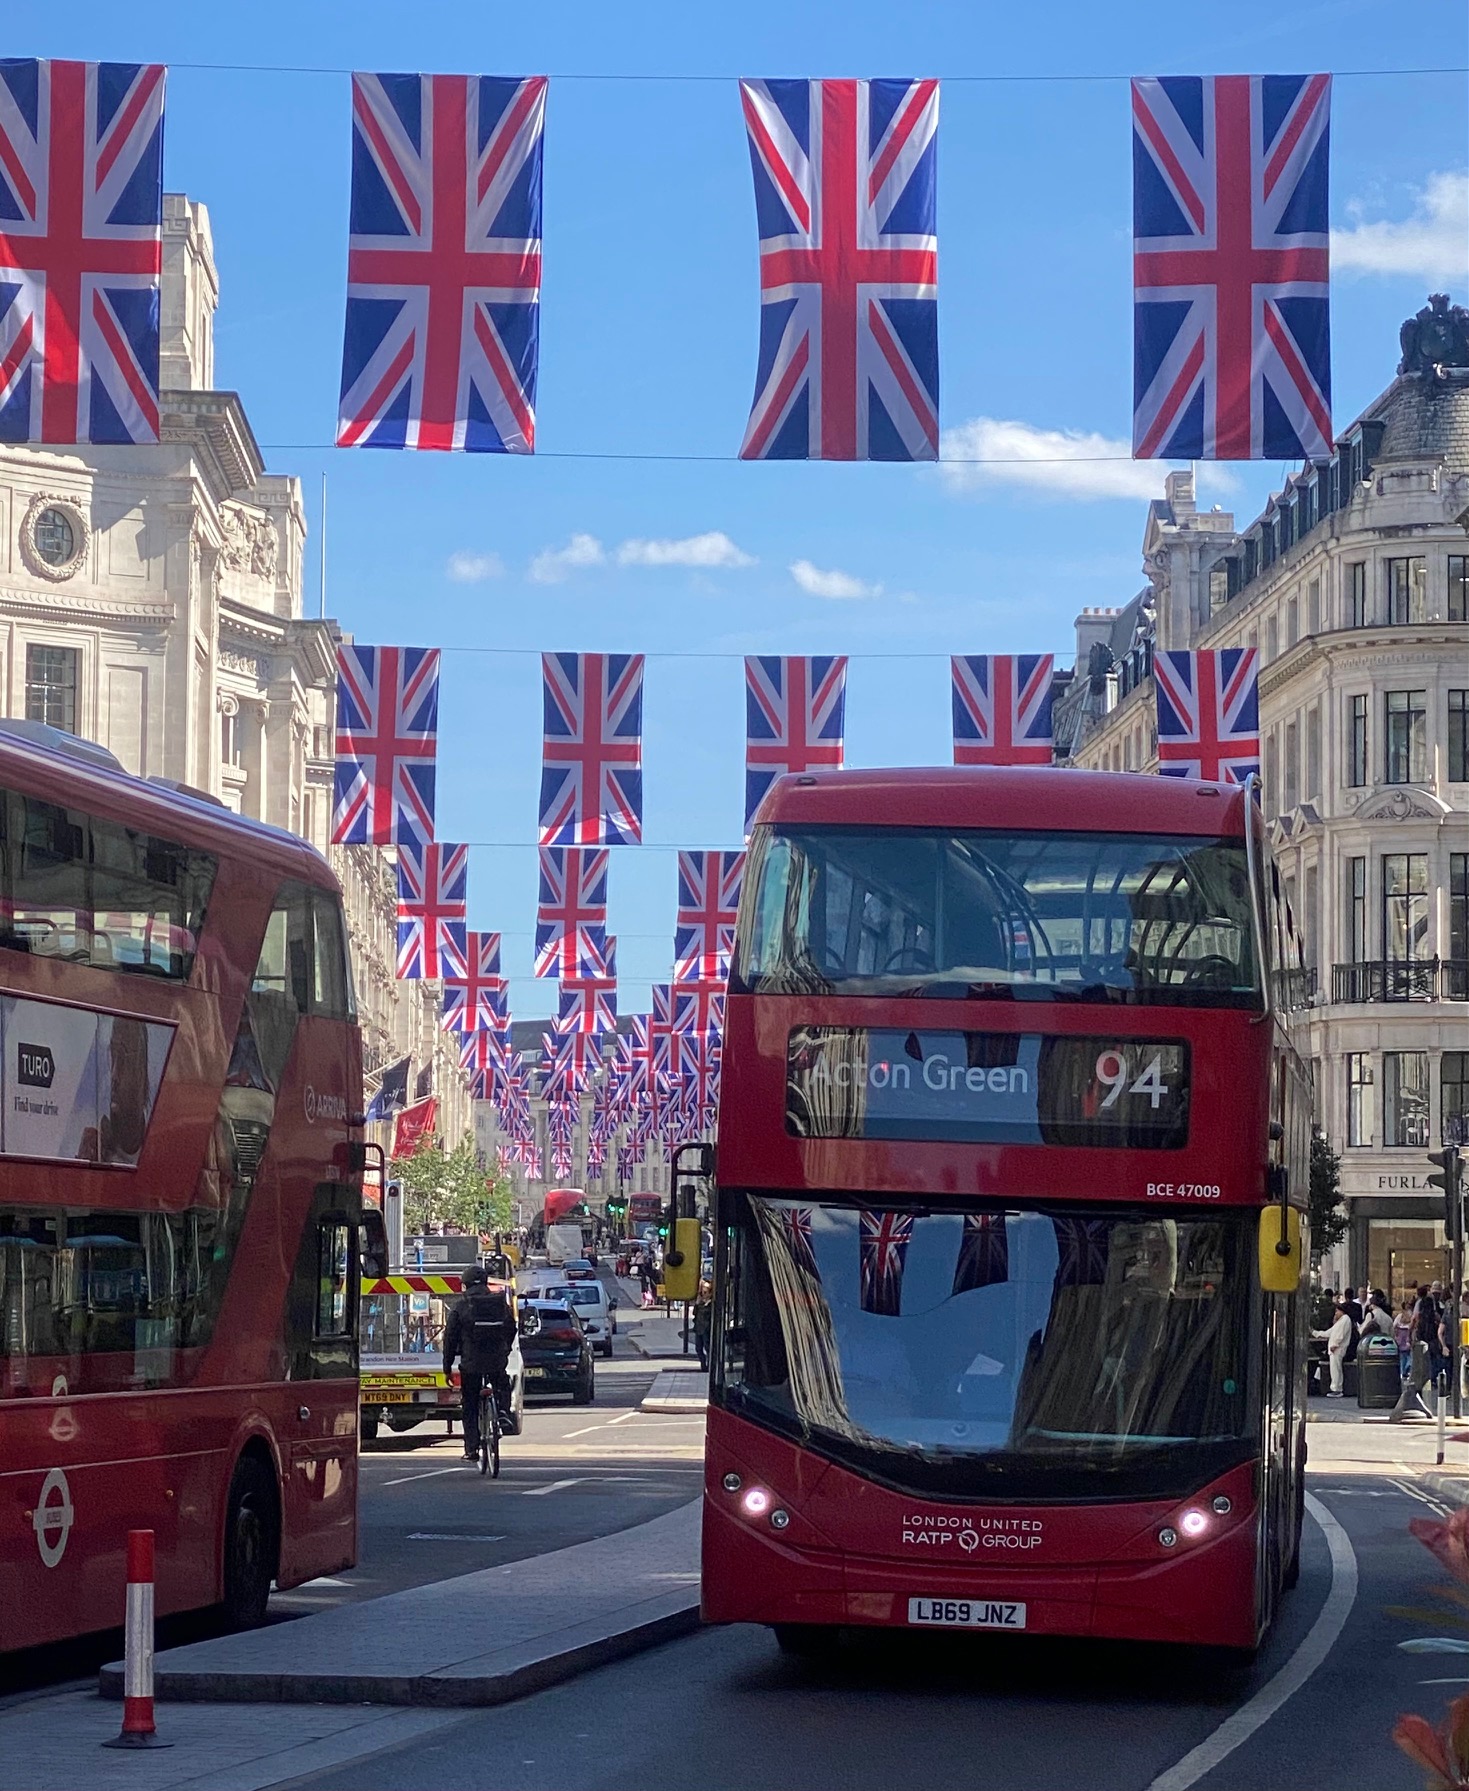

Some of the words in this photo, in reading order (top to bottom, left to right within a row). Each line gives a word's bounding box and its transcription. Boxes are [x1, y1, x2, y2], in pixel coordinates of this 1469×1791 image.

[22, 1053, 50, 1078] TURO
[810, 1051, 910, 1089] Acton
[922, 1053, 1028, 1093] Green
[1096, 1050, 1168, 1108] 94
[1146, 1183, 1174, 1196] BCE
[1176, 1183, 1221, 1198] 47009
[374, 1377, 431, 1385] MAINTENANCE
[902, 1515, 972, 1528] LONDON
[980, 1518, 1043, 1531] UNITED
[902, 1530, 953, 1545] RATP
[982, 1534, 1042, 1549] GROUP
[917, 1600, 971, 1622] LB69
[977, 1604, 1017, 1624] JNZ
